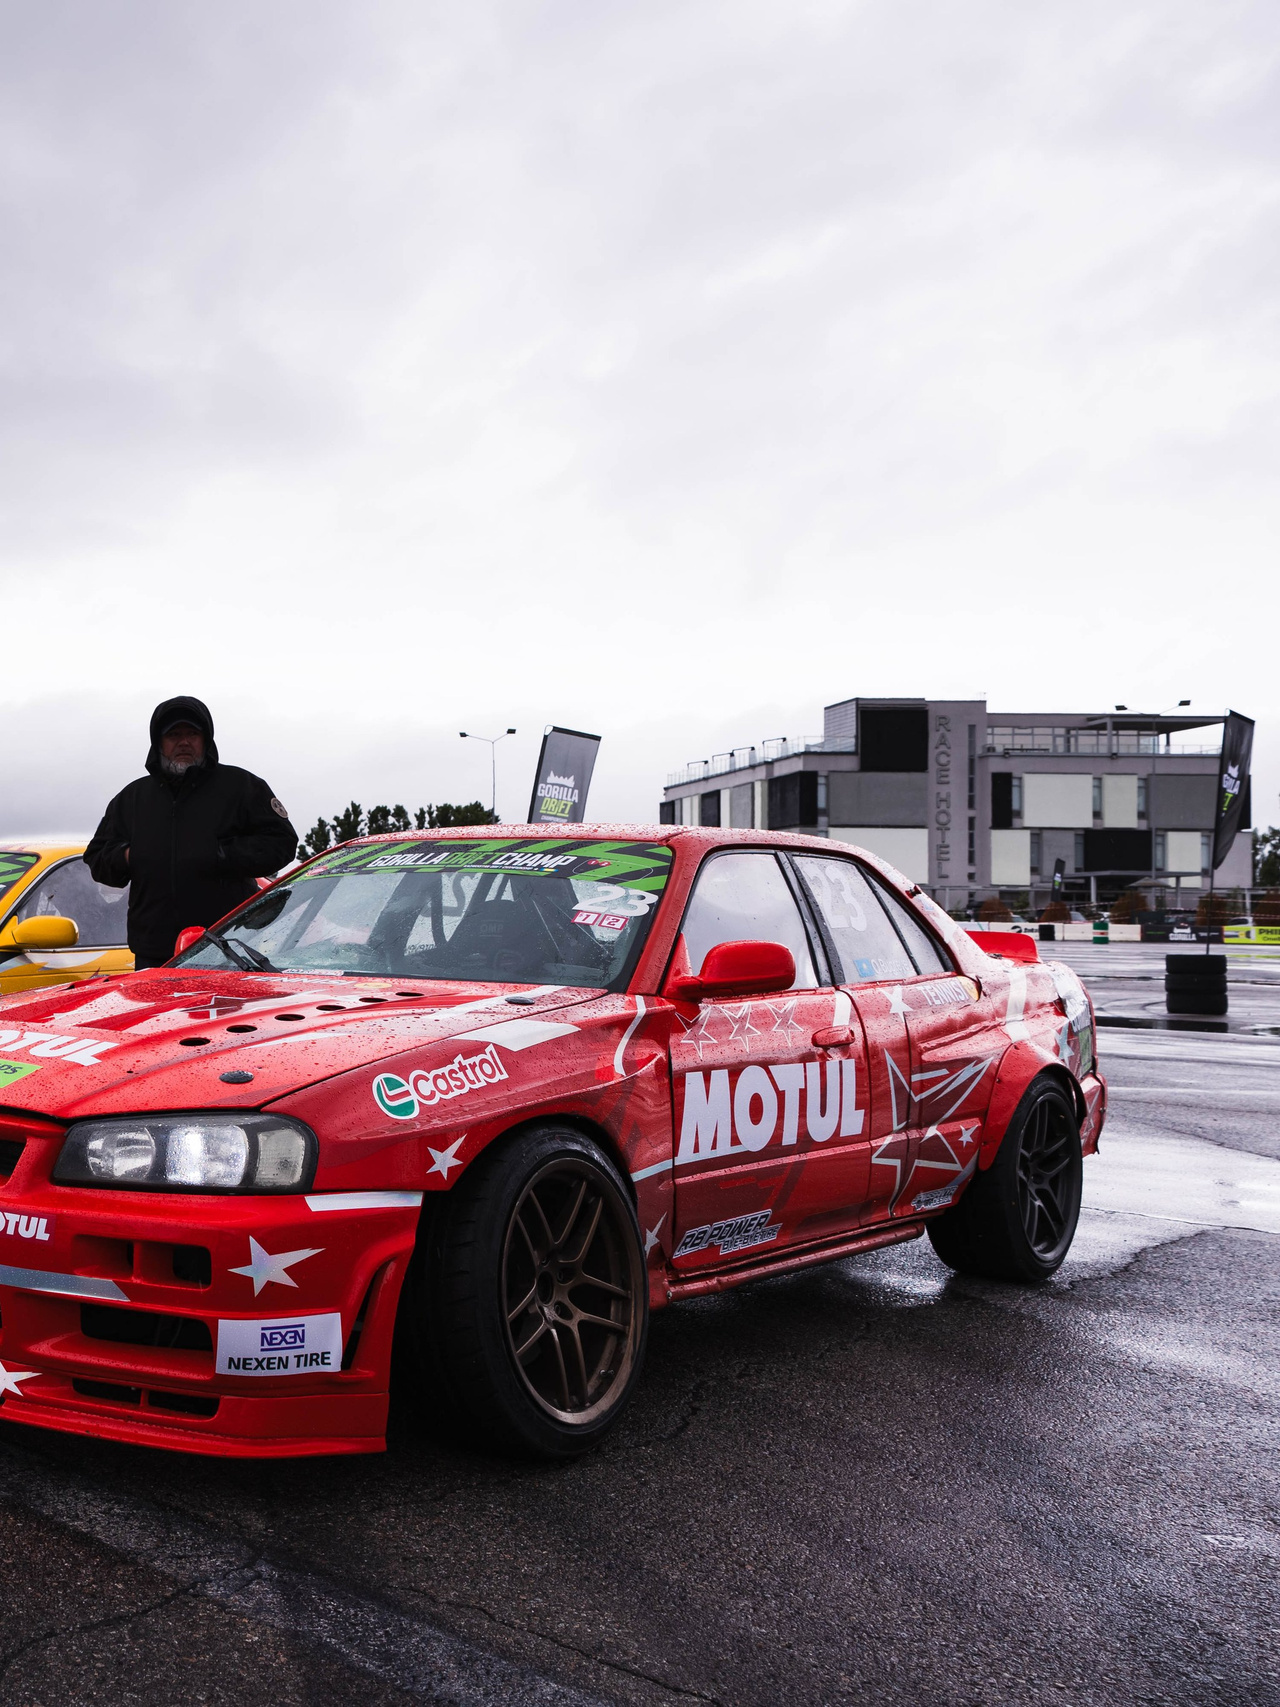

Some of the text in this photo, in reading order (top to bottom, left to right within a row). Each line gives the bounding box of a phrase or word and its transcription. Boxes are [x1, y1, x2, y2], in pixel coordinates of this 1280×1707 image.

[537, 783, 579, 803] GORILLA
[540, 797, 574, 817] DRIFT
[935, 715, 952, 879] RACE HOTEL
[572, 886, 659, 917] 23
[802, 864, 867, 932] 23
[412, 1050, 504, 1102] Castrol
[677, 1059, 865, 1159] MOTUL
[677, 1213, 771, 1253] RB POWER
[261, 1326, 305, 1350] NEXEN
[227, 1351, 332, 1371] NEXEN TIRE
